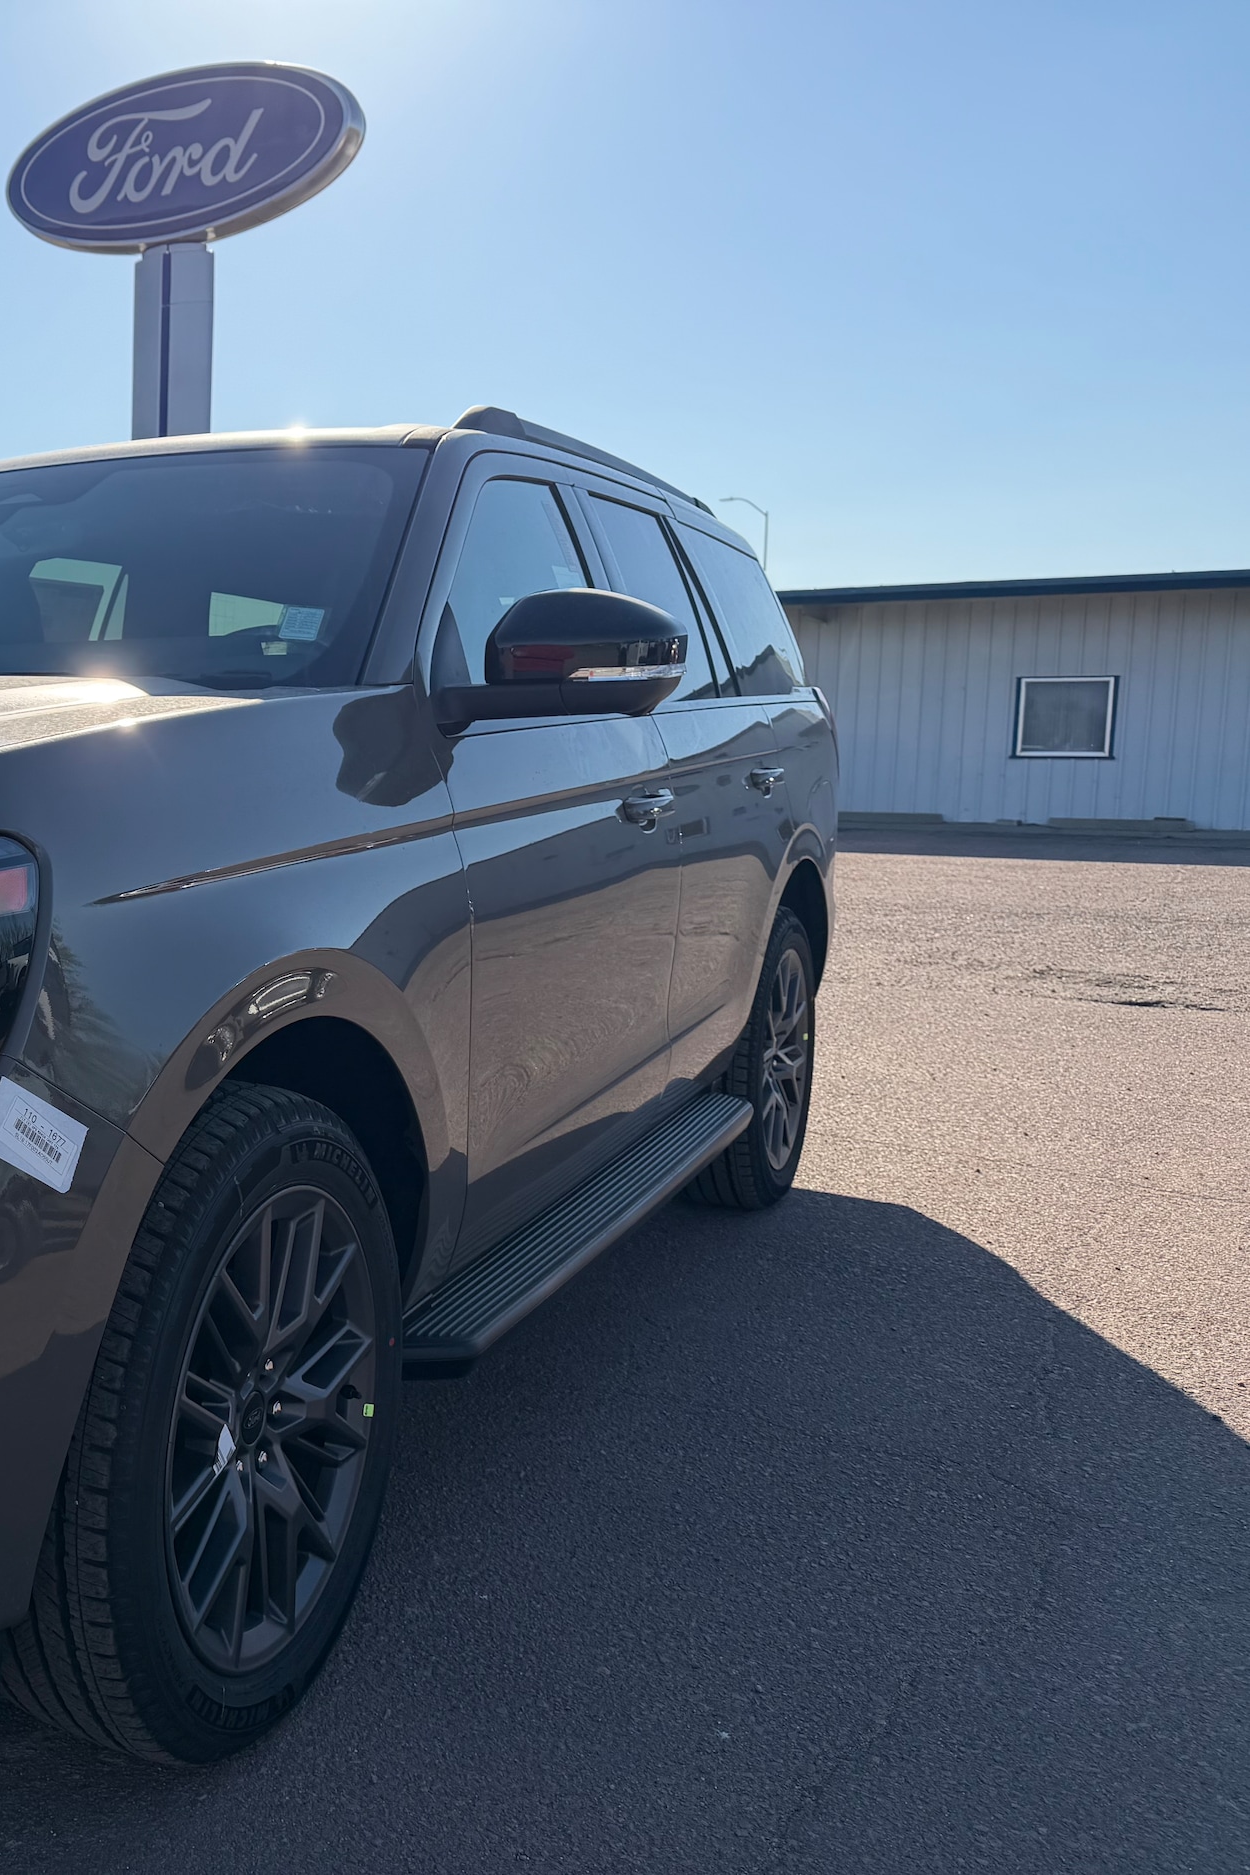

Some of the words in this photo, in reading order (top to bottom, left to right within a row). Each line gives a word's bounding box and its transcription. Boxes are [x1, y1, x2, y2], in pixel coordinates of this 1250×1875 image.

[68, 98, 265, 214] Ford
[23, 1108, 38, 1124] 110
[49, 1129, 67, 1148] 1677
[313, 1142, 377, 1206] MICHELIN
